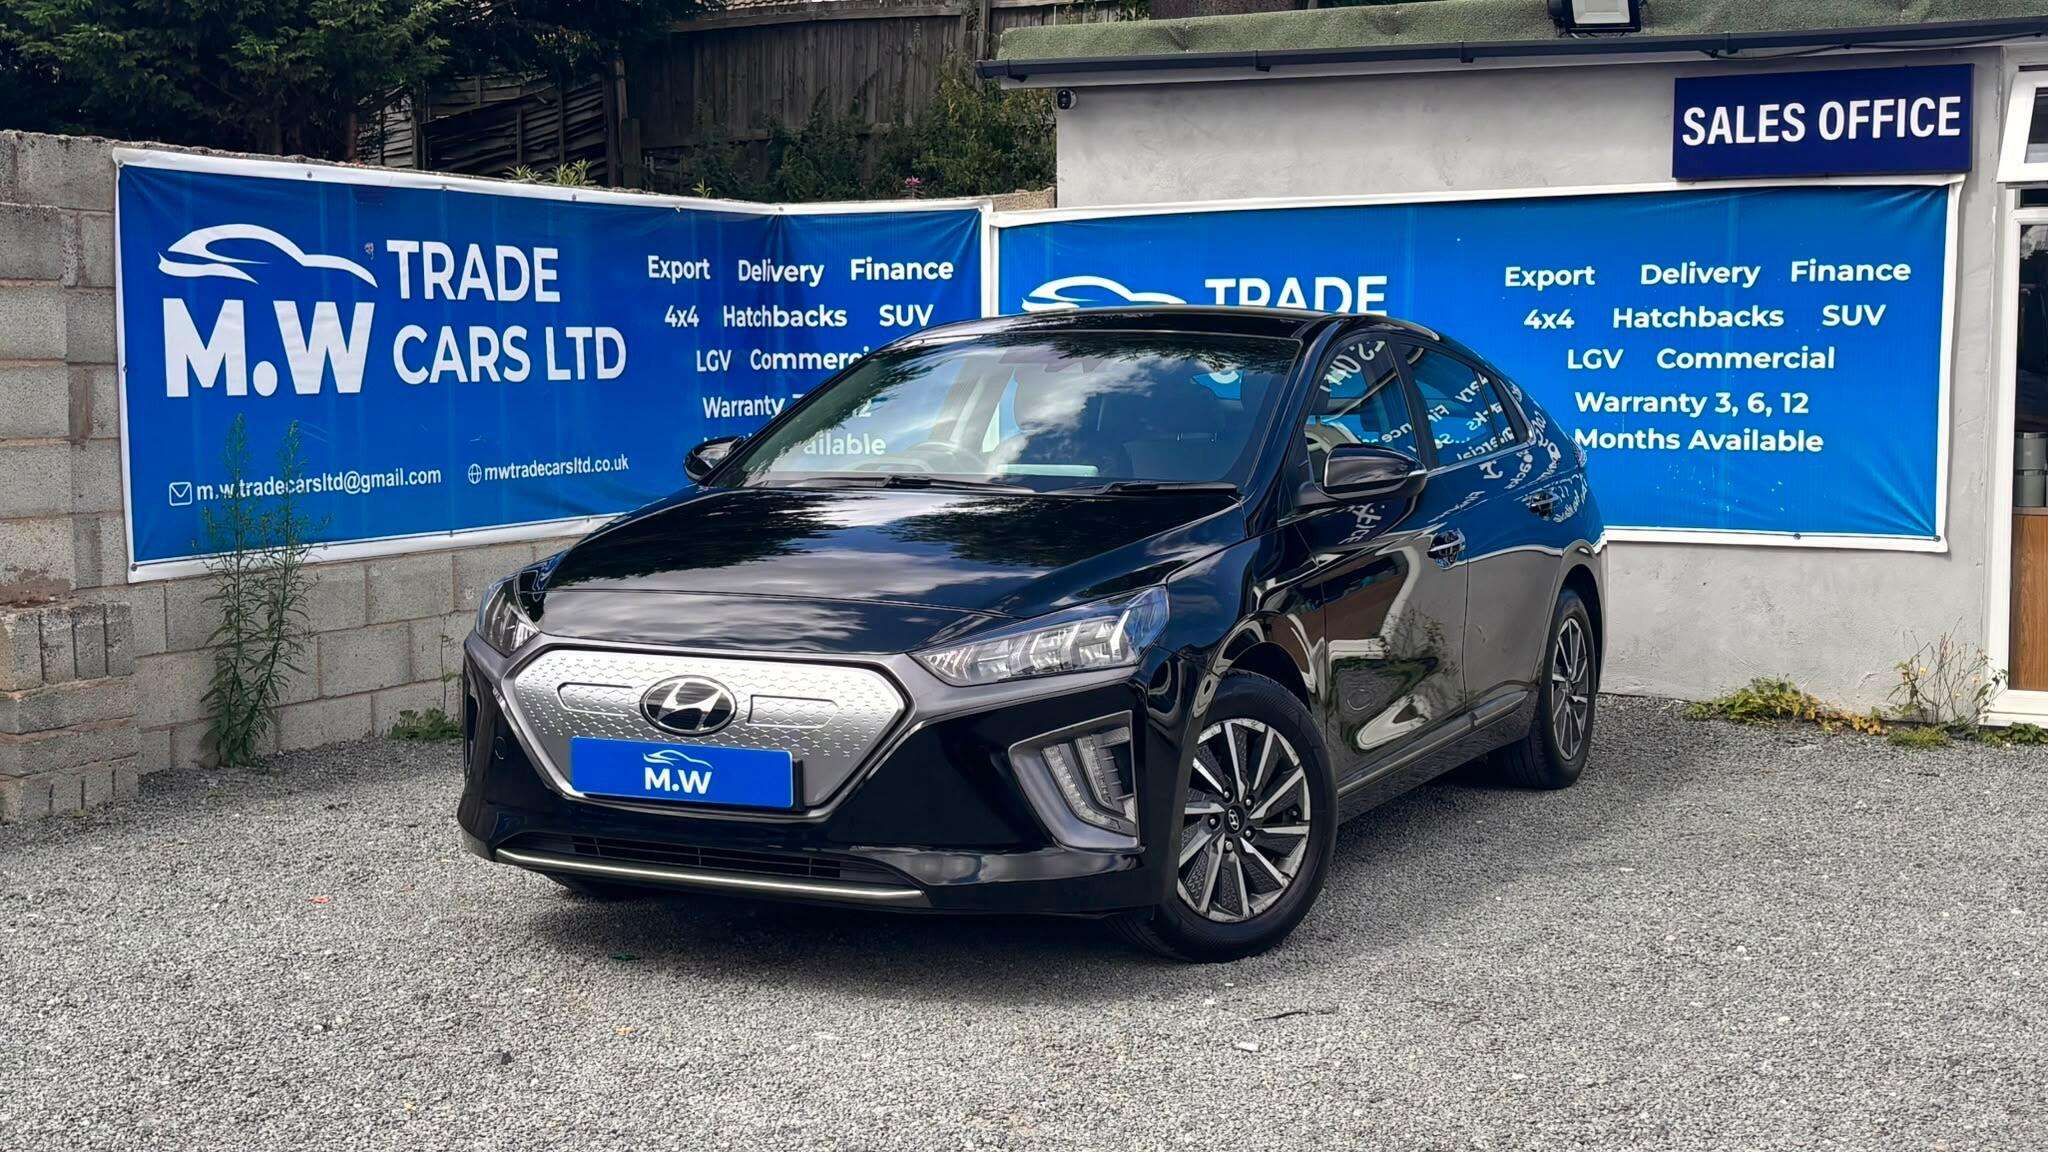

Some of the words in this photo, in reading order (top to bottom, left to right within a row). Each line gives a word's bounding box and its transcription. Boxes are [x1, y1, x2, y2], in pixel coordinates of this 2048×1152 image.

[1682, 102, 1806, 146] SALES
[1818, 95, 1961, 141] OFFICE
[386, 239, 561, 303] TRADE
[647, 255, 711, 284] Export
[738, 258, 825, 288] Delivery
[850, 256, 954, 281] Finance
[1505, 265, 1596, 291] Export
[1640, 261, 1761, 289] Delivery
[1791, 258, 1912, 282] Finance
[1204, 275, 1388, 316] TRADE
[664, 305, 700, 328] 4x4
[723, 304, 848, 328] Hatchbacks
[879, 303, 934, 327] SUV
[1523, 309, 1575, 330] 4x4
[1613, 304, 1785, 329] Hatchbacks
[1822, 304, 1886, 327] SUV
[163, 297, 375, 398] M.W
[393, 324, 531, 385] CARS
[545, 326, 627, 381] LTD
[696, 349, 732, 372] LGV
[1567, 348, 1624, 370] LGV
[1656, 345, 1835, 369] Commercial
[702, 395, 786, 419] Warranty
[1574, 391, 1708, 418] Warranty
[1714, 392, 1739, 417] 3,
[1747, 392, 1772, 417] 6,
[1781, 392, 1809, 414] 12
[803, 433, 887, 456] ailable
[1573, 427, 1681, 451] Months
[1688, 427, 1824, 452] Available
[484, 454, 629, 481] mwtradecarsltd.co.uk
[644, 767, 712, 794] M.W
